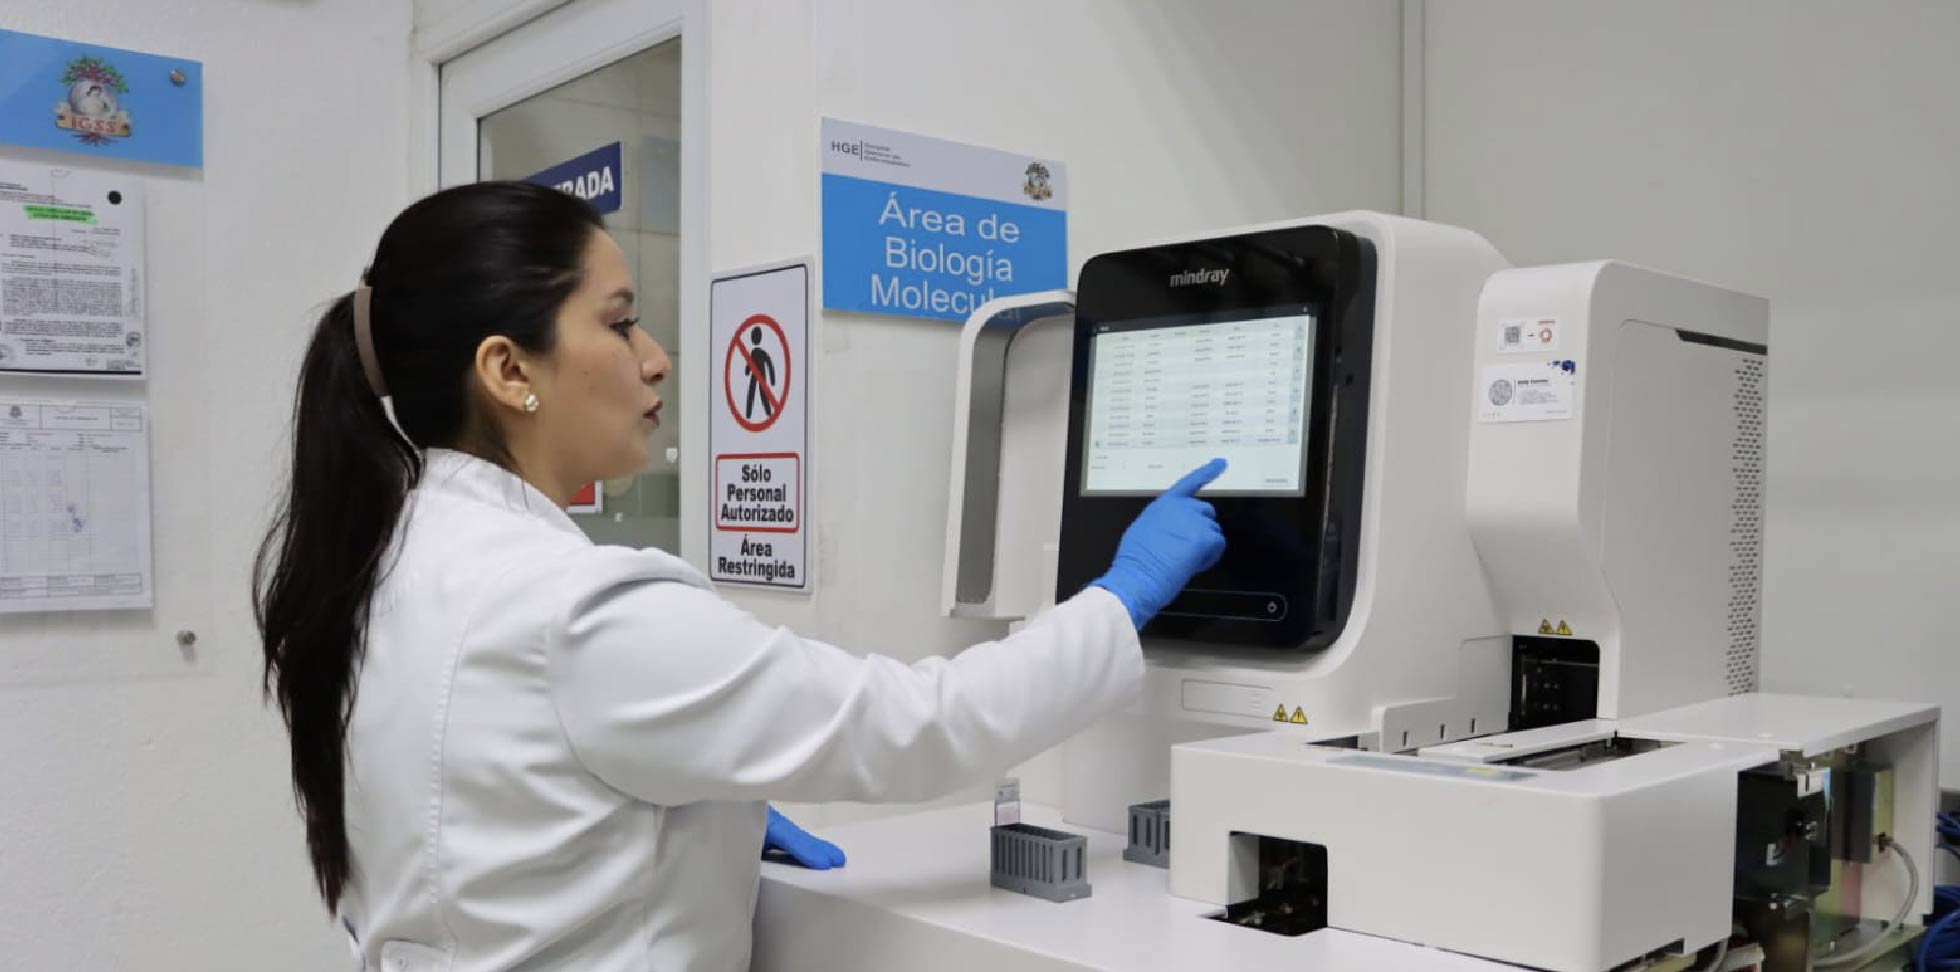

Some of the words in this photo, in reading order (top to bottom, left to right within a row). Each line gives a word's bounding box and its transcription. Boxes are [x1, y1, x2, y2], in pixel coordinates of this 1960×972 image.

[71, 116, 118, 134] IGSS
[831, 140, 860, 155] HGE
[879, 191, 966, 235] Área
[978, 213, 1020, 244] de
[885, 236, 1014, 287] Biología
[1169, 268, 1231, 288] mindray
[742, 464, 772, 482] Sólo
[726, 483, 787, 502] Personal
[721, 504, 794, 522] Autorizado
[740, 534, 773, 557] Área
[718, 557, 795, 581] Restringida
